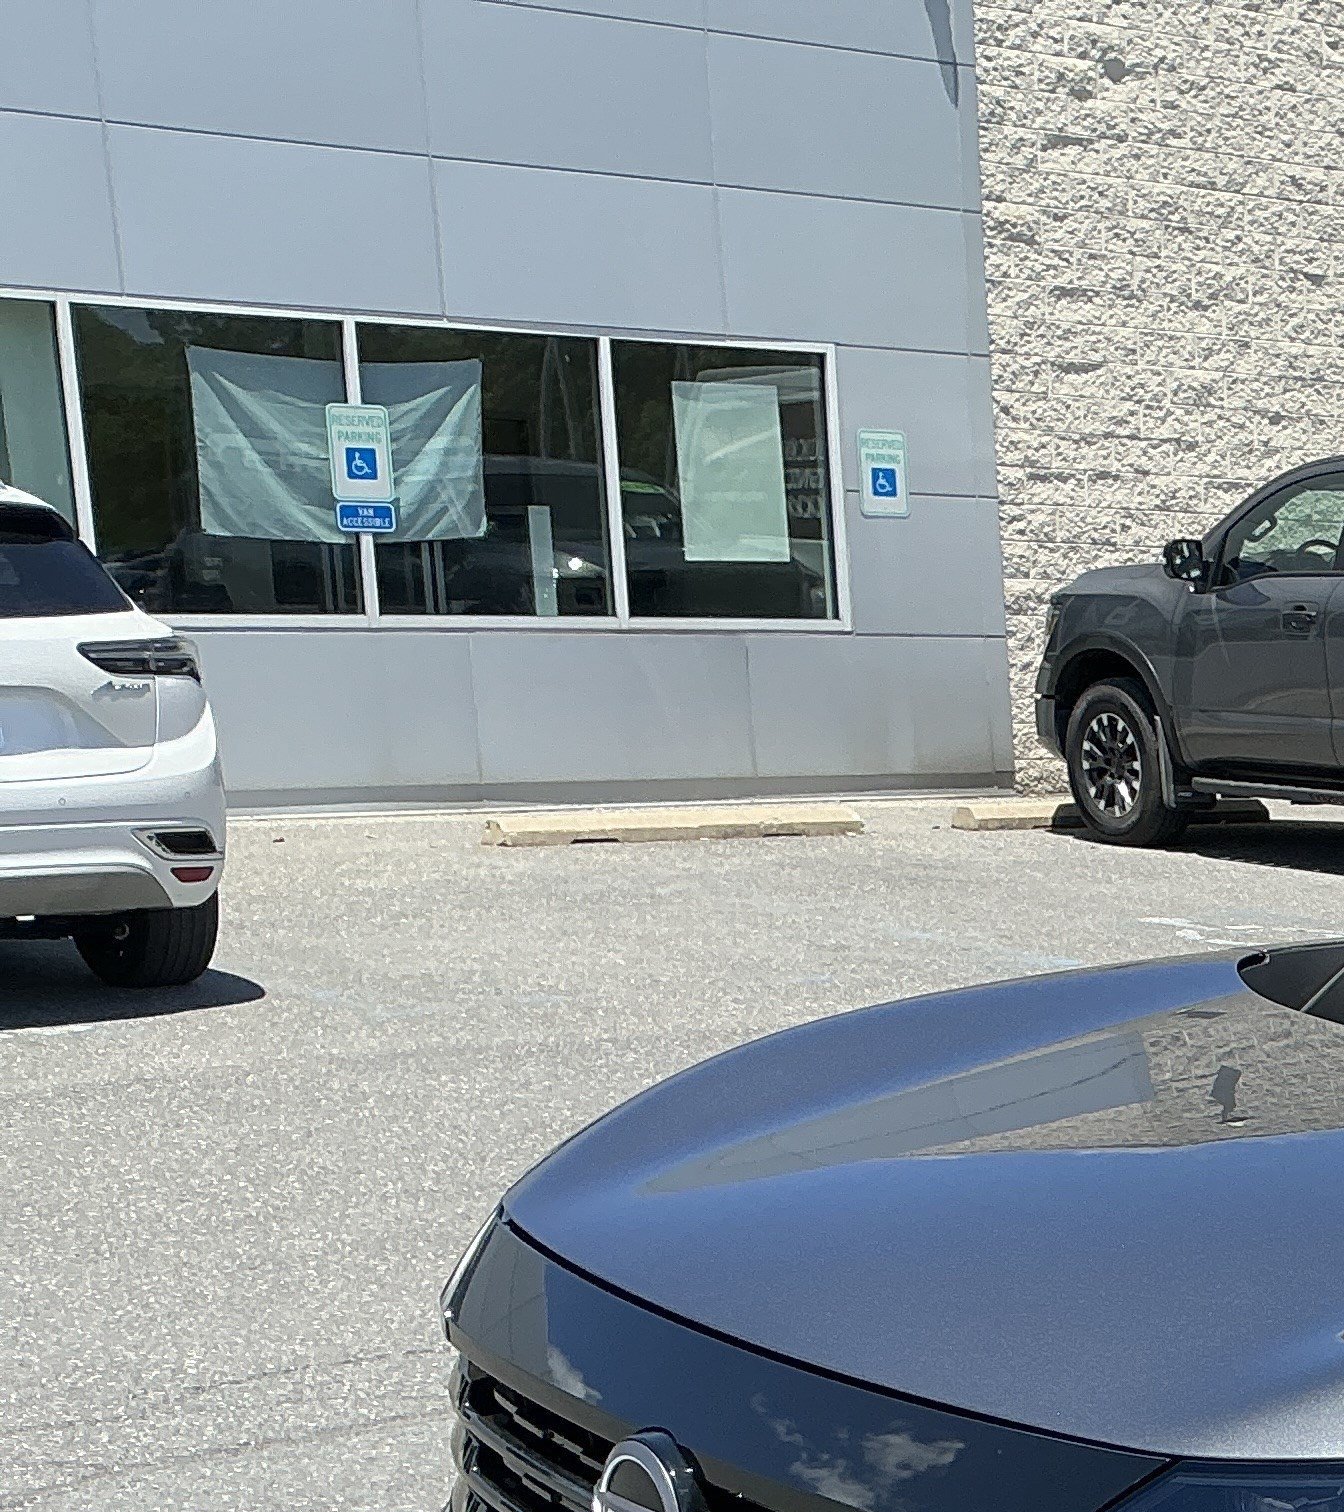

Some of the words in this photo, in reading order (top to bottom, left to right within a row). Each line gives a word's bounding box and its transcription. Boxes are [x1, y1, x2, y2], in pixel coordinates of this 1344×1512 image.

[330, 414, 384, 428] RESERVED
[337, 430, 383, 443] PARKING
[358, 507, 375, 517] VAN
[342, 517, 391, 527] ACCESSIBLE
